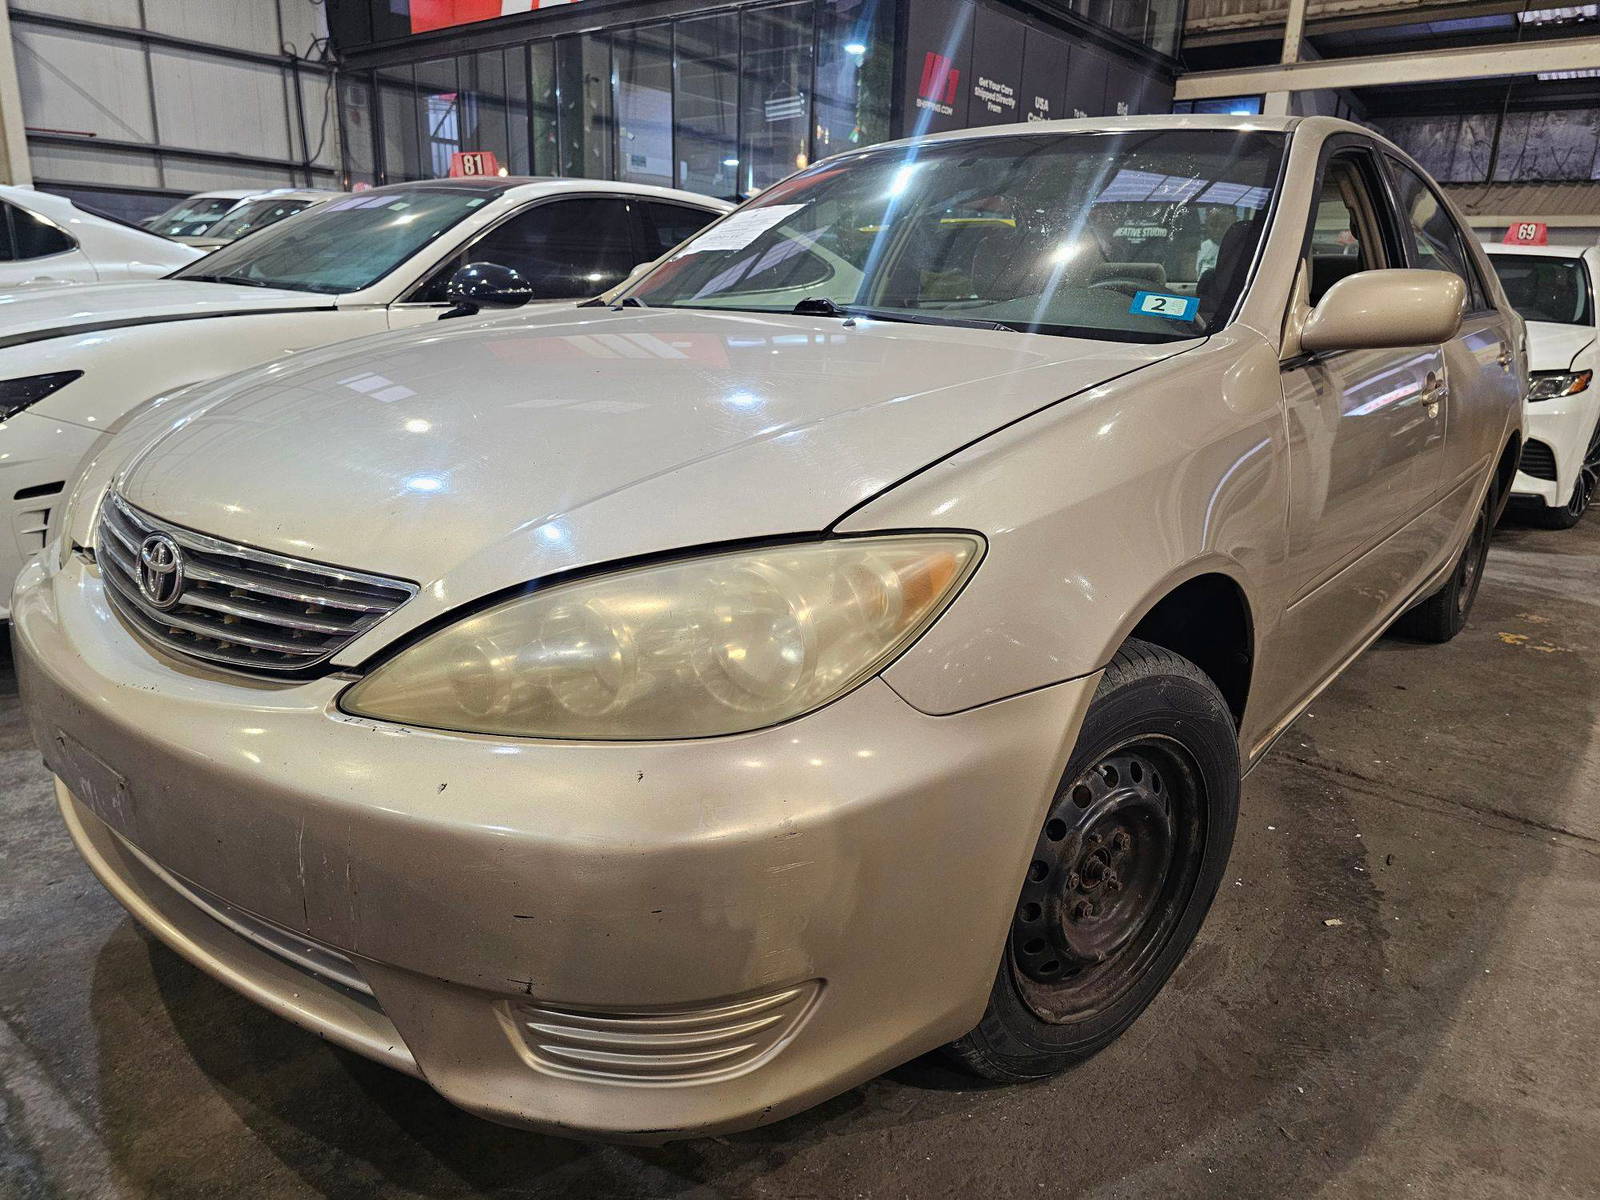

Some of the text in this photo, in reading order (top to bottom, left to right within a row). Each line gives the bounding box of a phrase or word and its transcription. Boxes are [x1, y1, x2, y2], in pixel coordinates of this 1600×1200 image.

[1034, 96, 1049, 112] USA
[463, 154, 484, 175] 81
[1518, 224, 1536, 240] 69
[1151, 298, 1167, 311] 2
